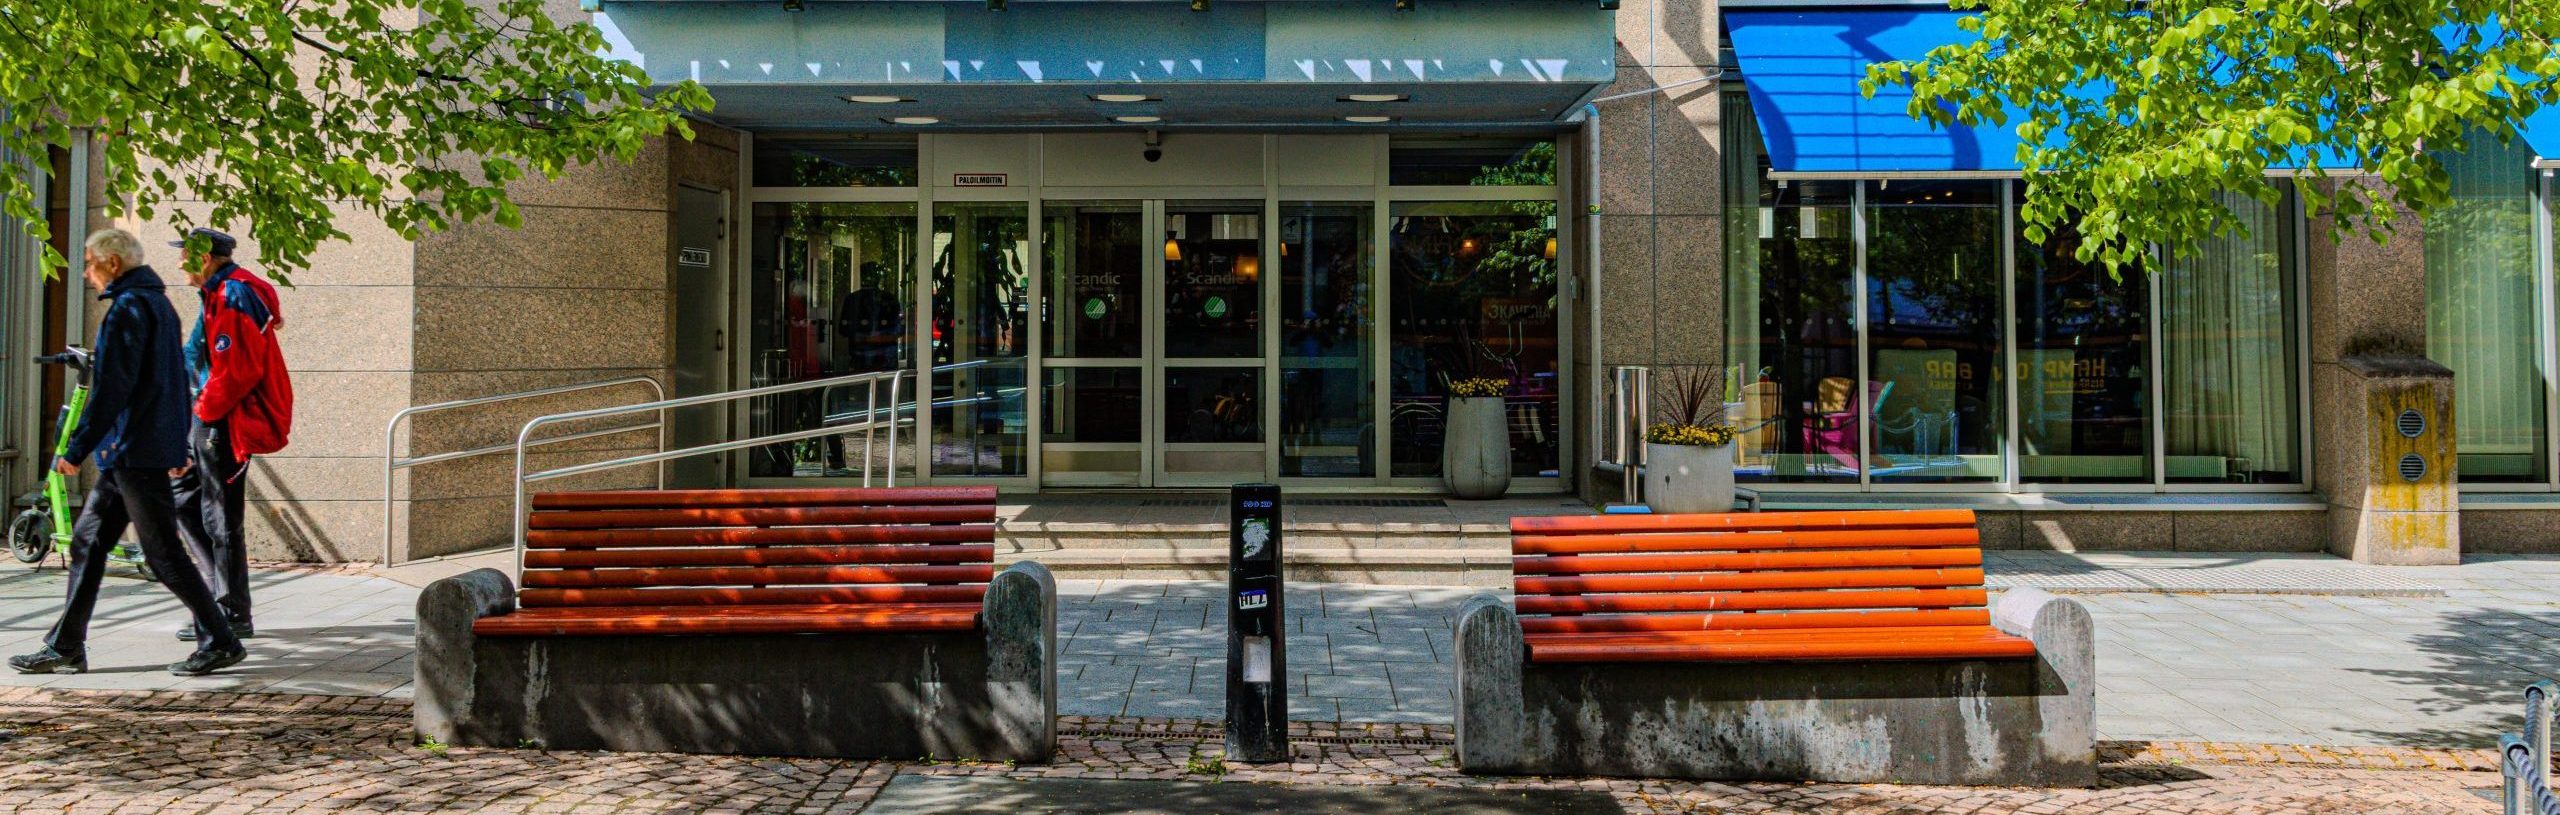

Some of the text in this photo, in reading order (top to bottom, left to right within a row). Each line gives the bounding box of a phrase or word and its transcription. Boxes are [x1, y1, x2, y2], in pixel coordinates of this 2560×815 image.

[958, 176, 1003, 185] PALOILMOITIN
[1063, 271, 1121, 285] candic
[1186, 271, 1247, 285] Scandic
